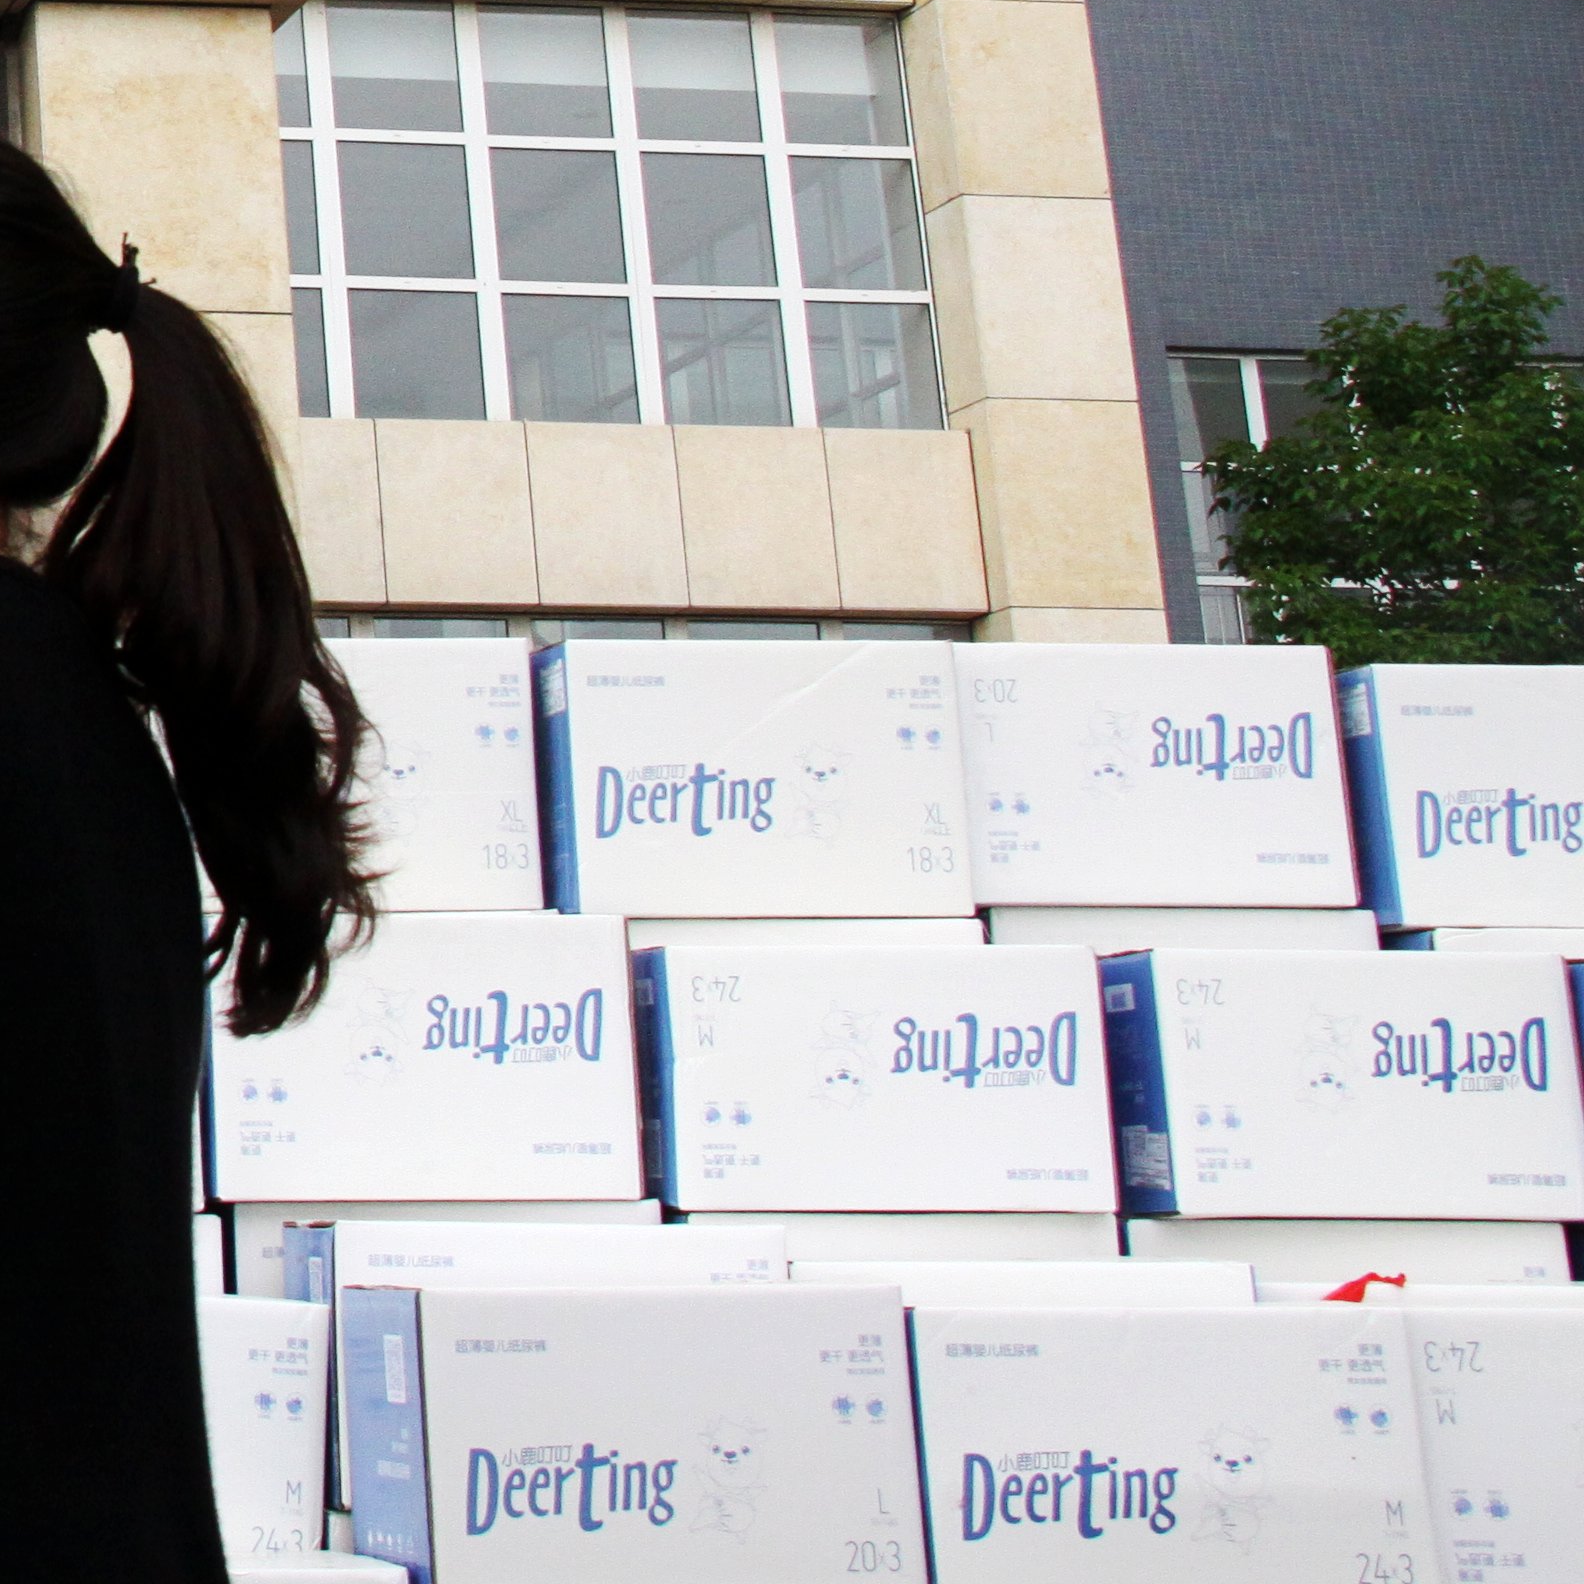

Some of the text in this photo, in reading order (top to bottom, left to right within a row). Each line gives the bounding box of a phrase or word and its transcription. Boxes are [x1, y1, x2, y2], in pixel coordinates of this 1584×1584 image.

[1151, 712, 1314, 781] Deerting
[595, 762, 777, 839] Deerting
[1415, 787, 1584, 859] Deerting
[423, 988, 604, 1064] Deerting
[697, 1024, 715, 1048] M
[890, 1011, 1077, 1088] Deerting
[1183, 1027, 1201, 1051] M
[1370, 1017, 1548, 1093] Deerting
[1436, 1399, 1456, 1425] M
[467, 1442, 679, 1537] Deerting
[501, 1445, 574, 1468] 小鹿叮叮
[285, 1480, 303, 1505] M
[877, 1488, 891, 1515] L
[962, 1449, 1179, 1541] Deerting
[1385, 1500, 1404, 1527] M
